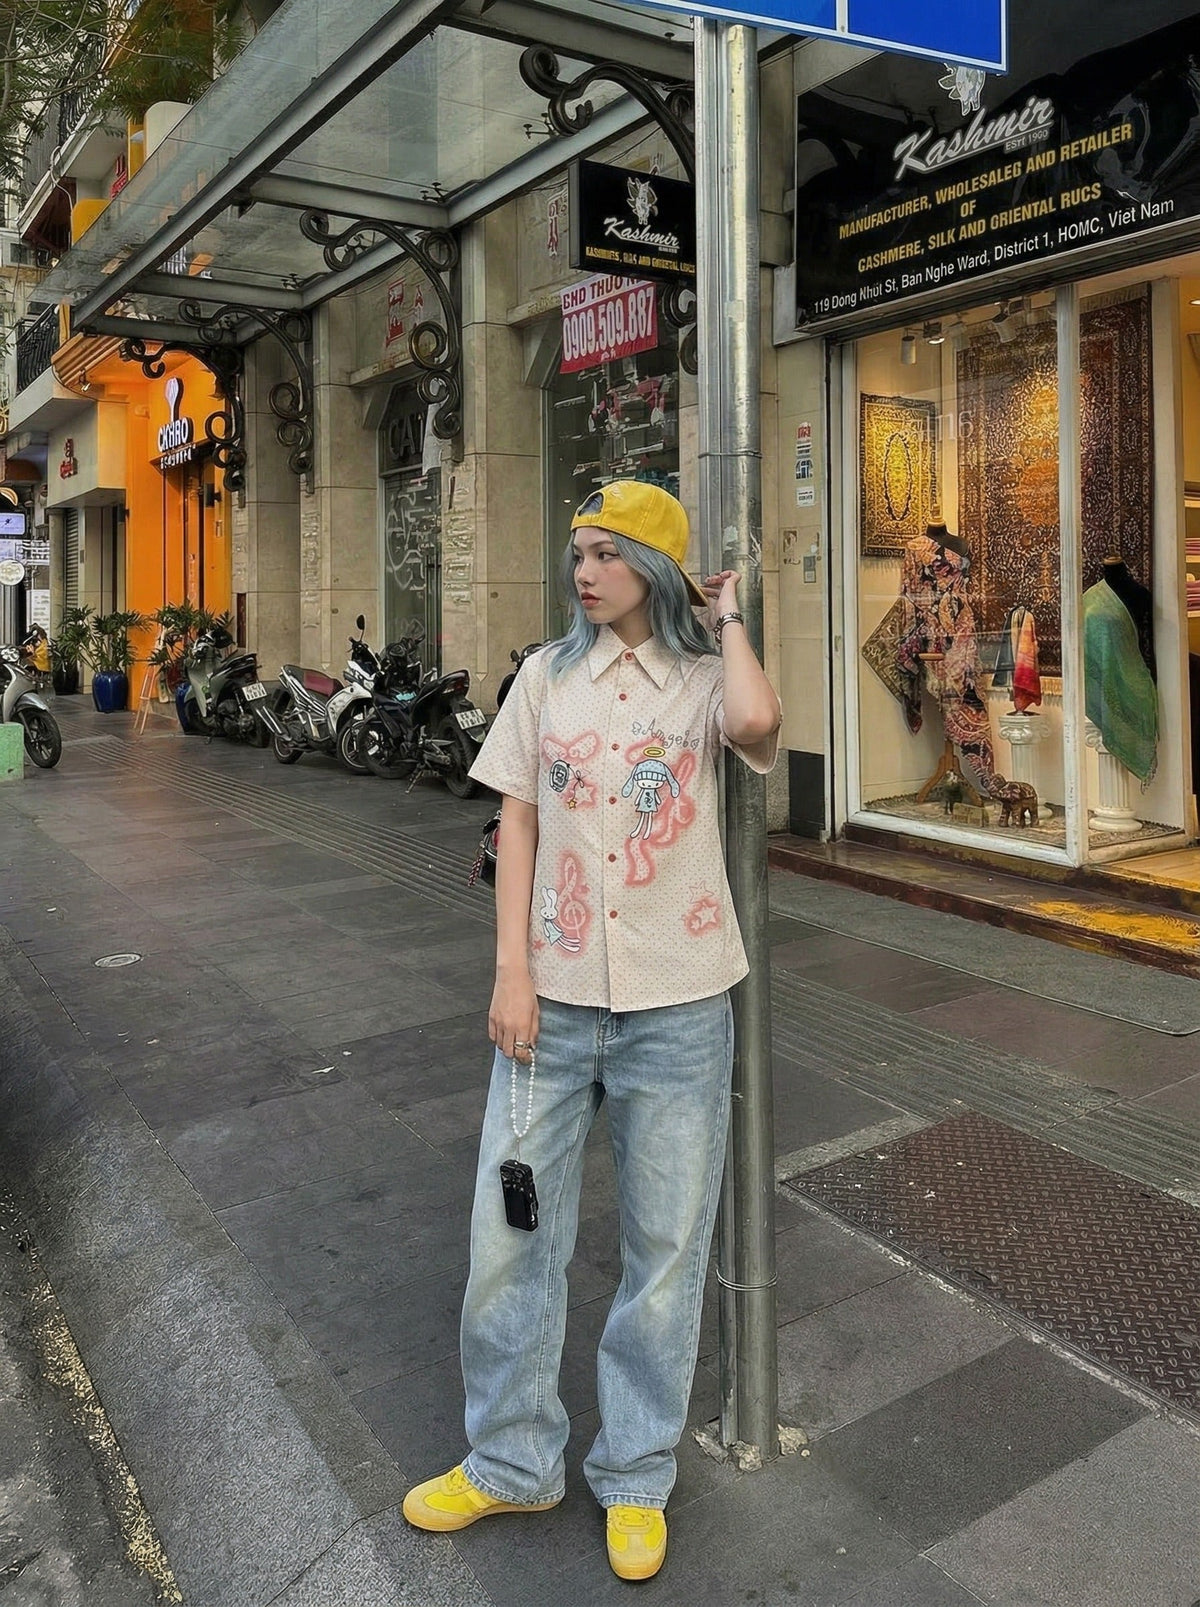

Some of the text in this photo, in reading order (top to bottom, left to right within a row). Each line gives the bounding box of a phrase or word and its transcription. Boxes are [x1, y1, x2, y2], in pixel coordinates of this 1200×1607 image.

[895, 97, 1053, 179] Kashmir
[839, 195, 932, 240] MANUFACTURER,
[1026, 149, 1056, 174] AND
[1060, 123, 1132, 163] RETAILER
[960, 199, 977, 218] OF
[603, 217, 679, 247] Kashmir
[814, 297, 830, 314] 119
[901, 272, 922, 289] Ban
[925, 263, 955, 283] Nghe
[957, 249, 991, 272] Ward,
[994, 234, 1039, 261] District
[1140, 199, 1174, 220] Nam
[928, 227, 956, 250] SILK
[959, 218, 986, 241] AND
